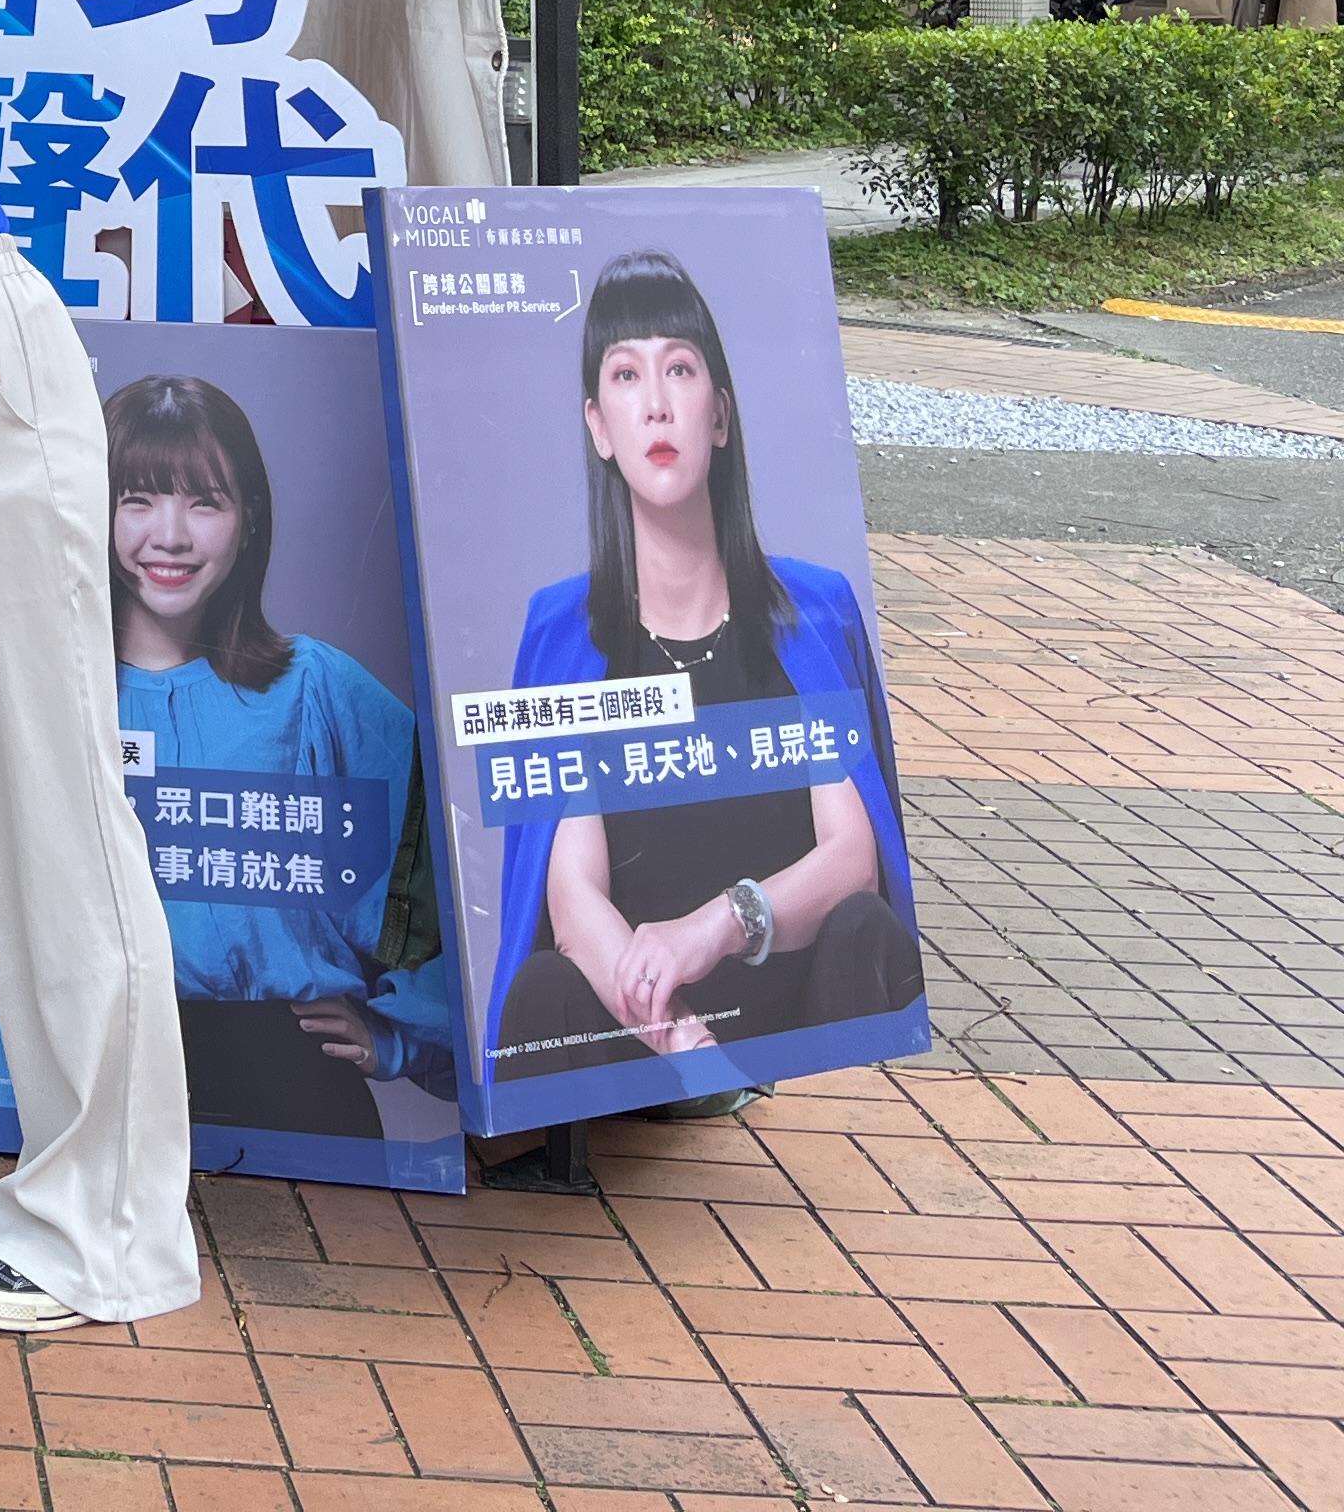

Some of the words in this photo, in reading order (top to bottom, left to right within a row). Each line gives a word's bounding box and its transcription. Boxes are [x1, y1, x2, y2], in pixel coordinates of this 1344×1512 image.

[403, 206, 464, 224] VOCAL
[405, 228, 471, 247] MIDDLE
[485, 227, 583, 246] 布爾喬亞公關顧問
[422, 273, 526, 296] 跨境公關服務
[422, 301, 505, 315] Border-to-Border
[507, 301, 520, 313] PR
[521, 300, 561, 312] Services
[485, 1045, 518, 1059] Copyright
[525, 1041, 541, 1053] 2022
[541, 1037, 563, 1051] VOCAL
[563, 1032, 589, 1047] MIDDLE
[588, 1025, 640, 1044] Communications
[716, 1007, 742, 1022] reserved
